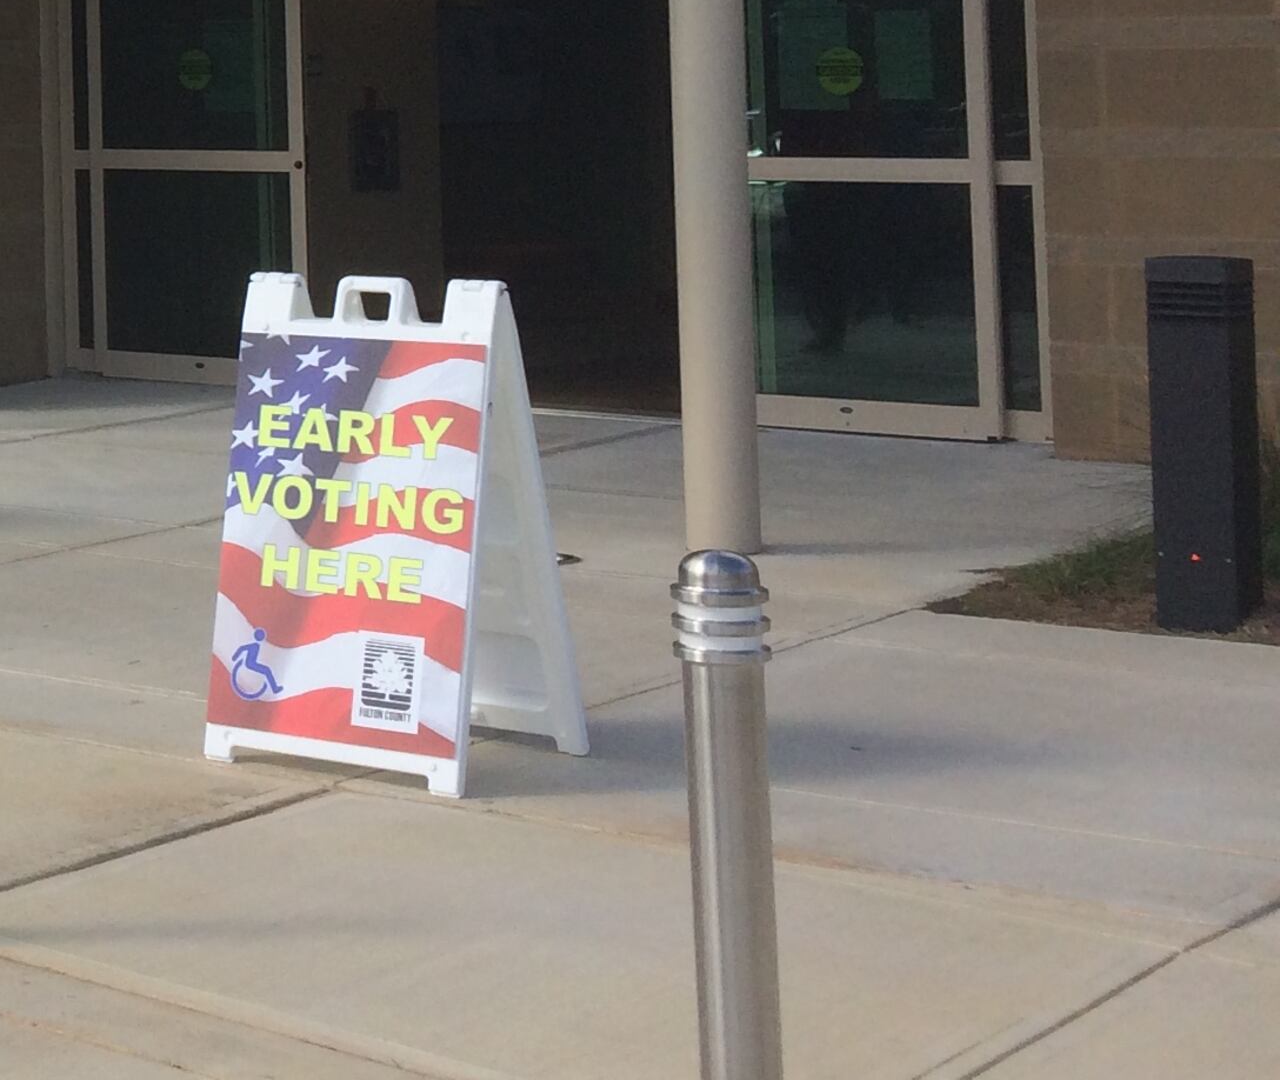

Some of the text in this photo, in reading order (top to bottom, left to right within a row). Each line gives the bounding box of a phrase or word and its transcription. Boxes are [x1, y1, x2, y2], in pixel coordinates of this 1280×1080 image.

[257, 405, 454, 460] EARLY
[235, 472, 465, 535] VOTING
[260, 544, 423, 604] HERE
[359, 707, 411, 722] FULTON COUNTY
